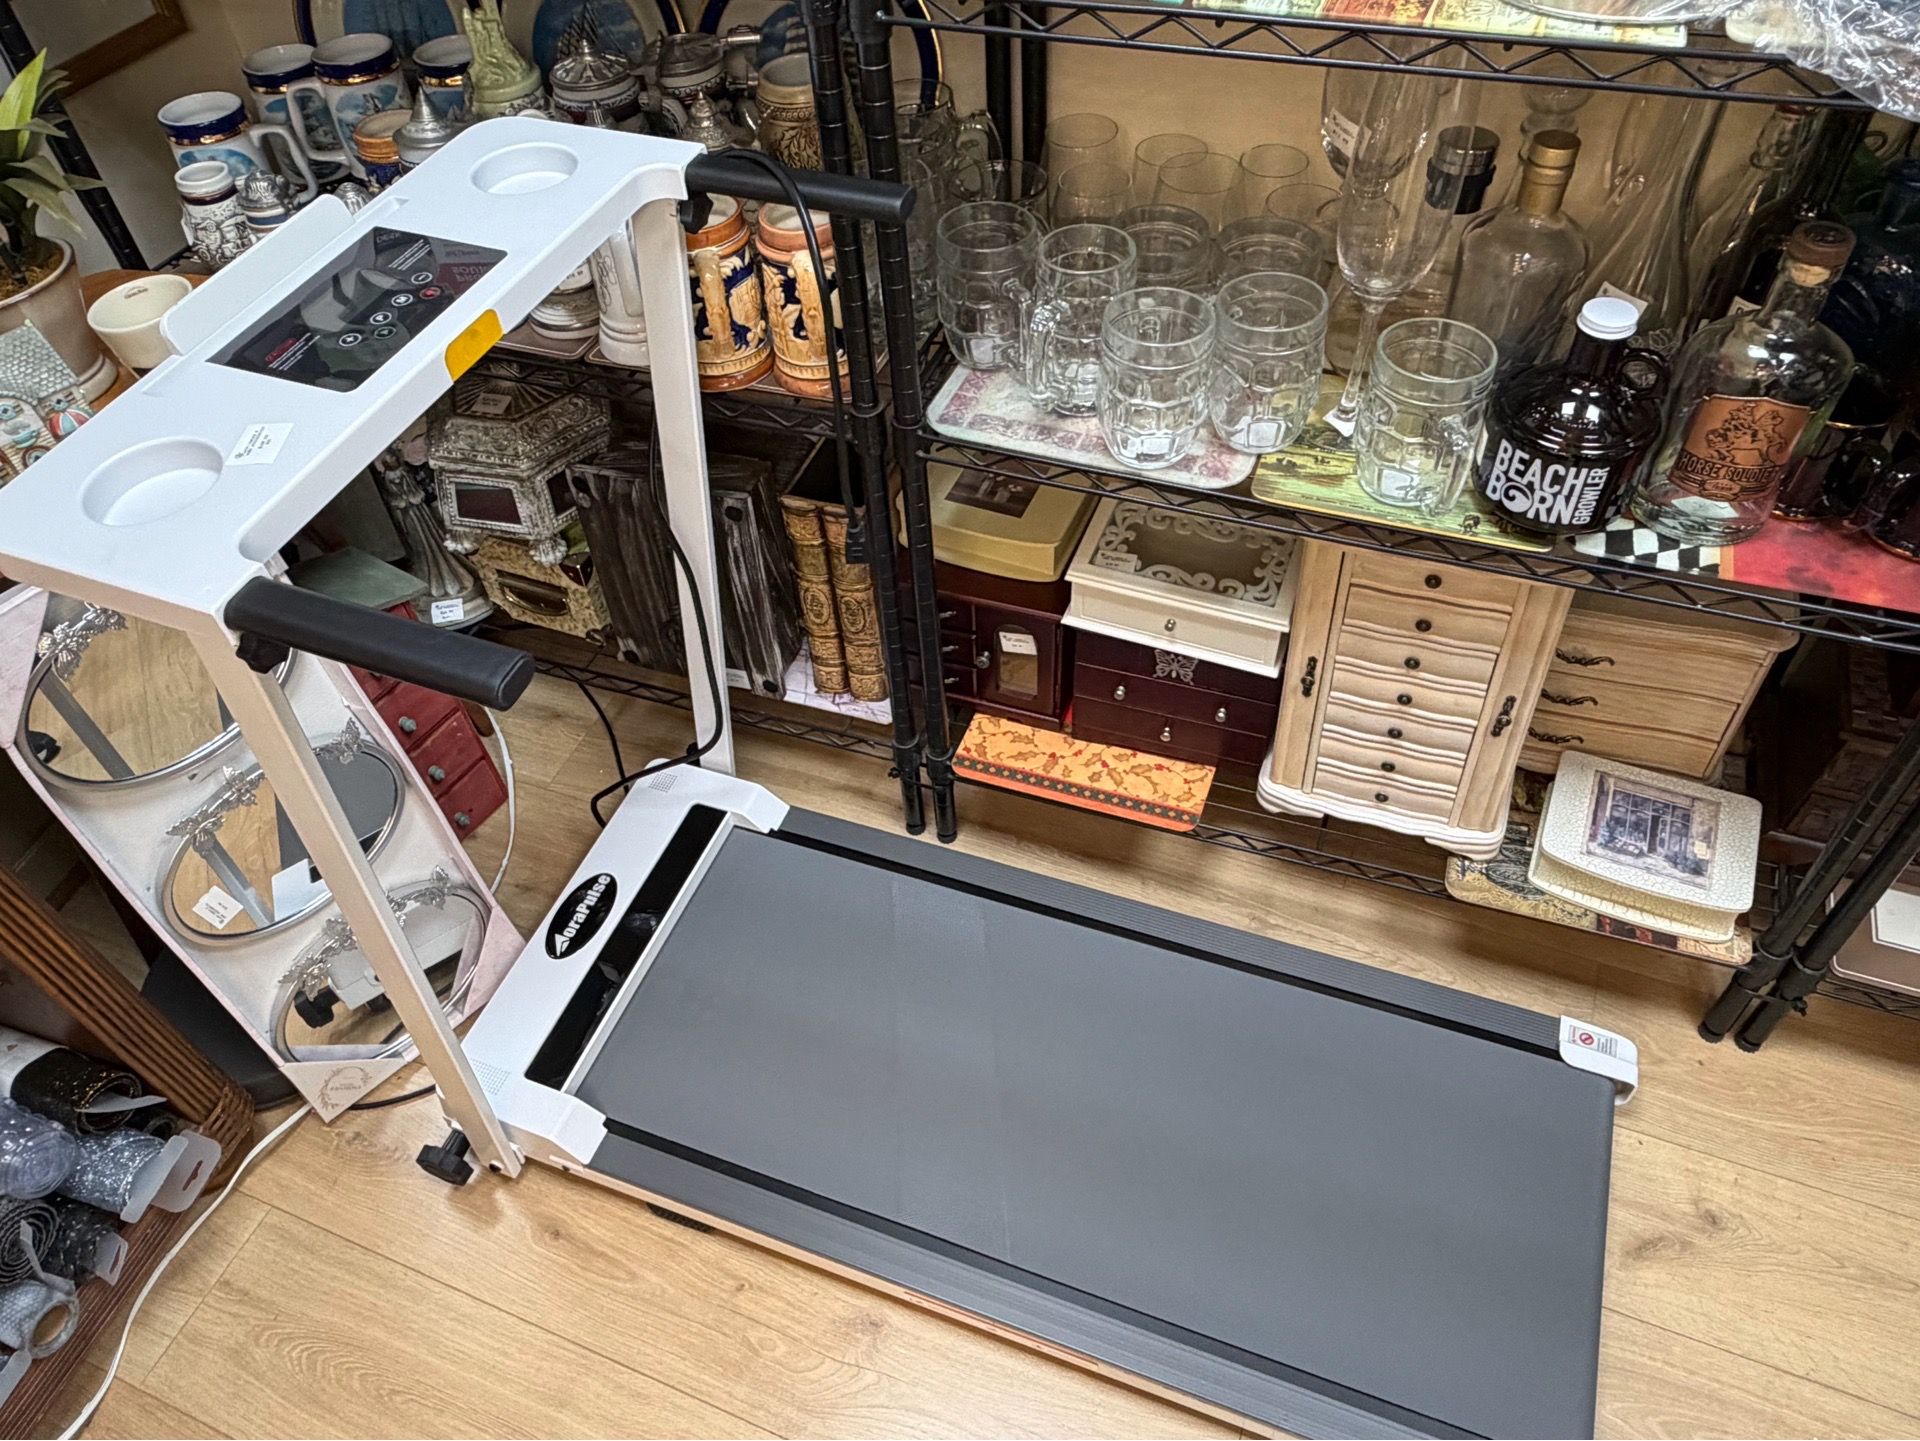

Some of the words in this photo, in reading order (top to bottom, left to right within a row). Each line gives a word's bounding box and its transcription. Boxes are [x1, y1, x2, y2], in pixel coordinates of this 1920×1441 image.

[1495, 438, 1589, 496] BEACH
[1678, 454, 1722, 477] HORSE
[1572, 466, 1611, 525] GROWLER
